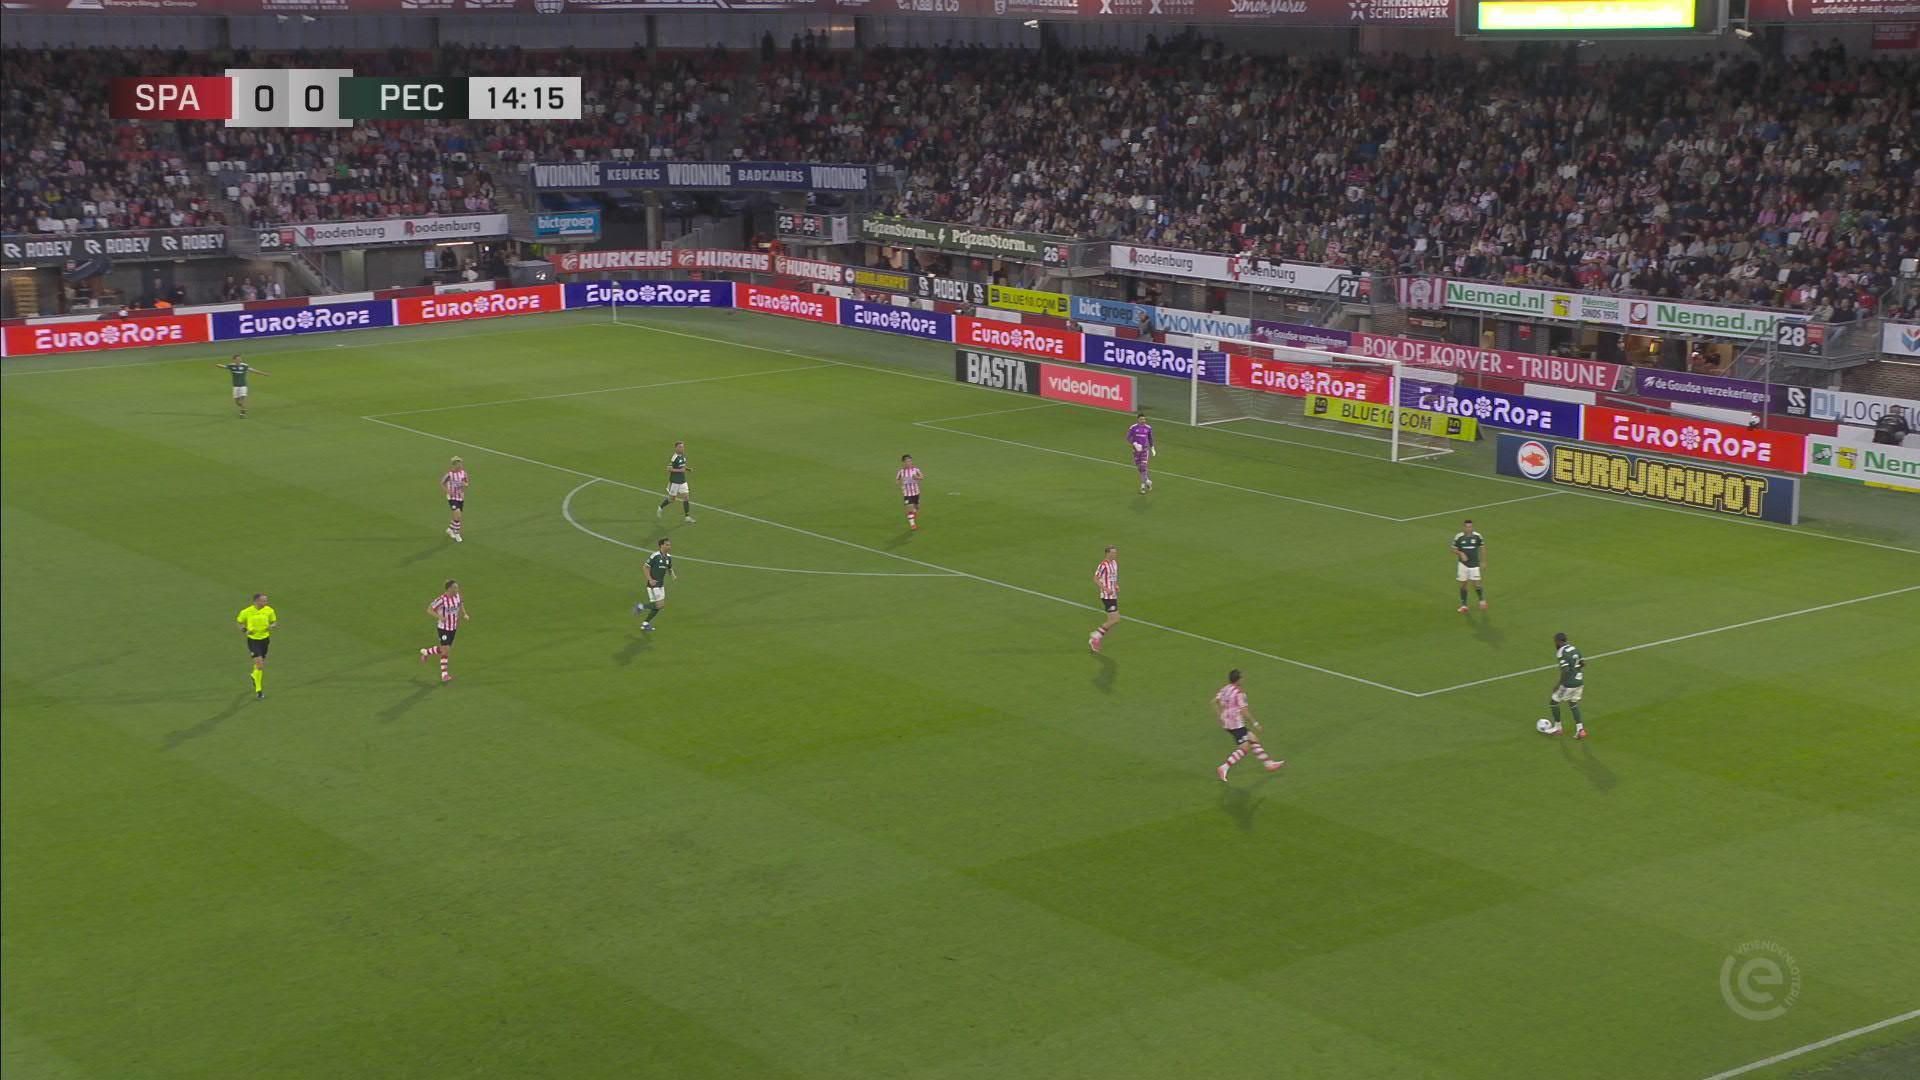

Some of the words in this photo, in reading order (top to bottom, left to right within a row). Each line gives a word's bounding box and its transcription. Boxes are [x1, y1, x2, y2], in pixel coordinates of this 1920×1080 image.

[1369, 8, 1448, 18] SCHILDERWERK
[534, 164, 600, 187] WOONING
[607, 168, 660, 180] KEUKENS
[668, 164, 732, 186] WOONING
[738, 169, 804, 182] BADKAMERS
[810, 166, 868, 190] WOONING
[538, 216, 594, 231] bictgroep
[780, 216, 794, 229] 25
[26, 240, 72, 258] ROBEY
[106, 238, 150, 253] ROBEY
[182, 234, 224, 250] ROBEY
[260, 233, 280, 247] 23
[579, 250, 672, 269] HURKENS
[696, 251, 768, 270] HURKENS
[1044, 246, 1058, 262] 26
[1129, 248, 1193, 272] Roodenburg
[786, 260, 842, 282] HURKENS
[934, 278, 968, 301] ROBEY
[1340, 280, 1359, 298] 27
[1447, 284, 1544, 310] Nemad.nl
[1079, 298, 1133, 322] bictgroep
[1656, 304, 1776, 332] Nemad.nl
[1780, 326, 1806, 346] 28
[1362, 336, 1398, 360] BOK
[1403, 342, 1425, 363] DE
[1430, 345, 1502, 373] KORVER
[1518, 356, 1606, 387] TRIBUNE
[966, 352, 1028, 393] BASTA
[1655, 378, 1667, 390] de
[1667, 380, 1701, 394] Goudse
[1554, 447, 1766, 516] EUROJACKPOT
